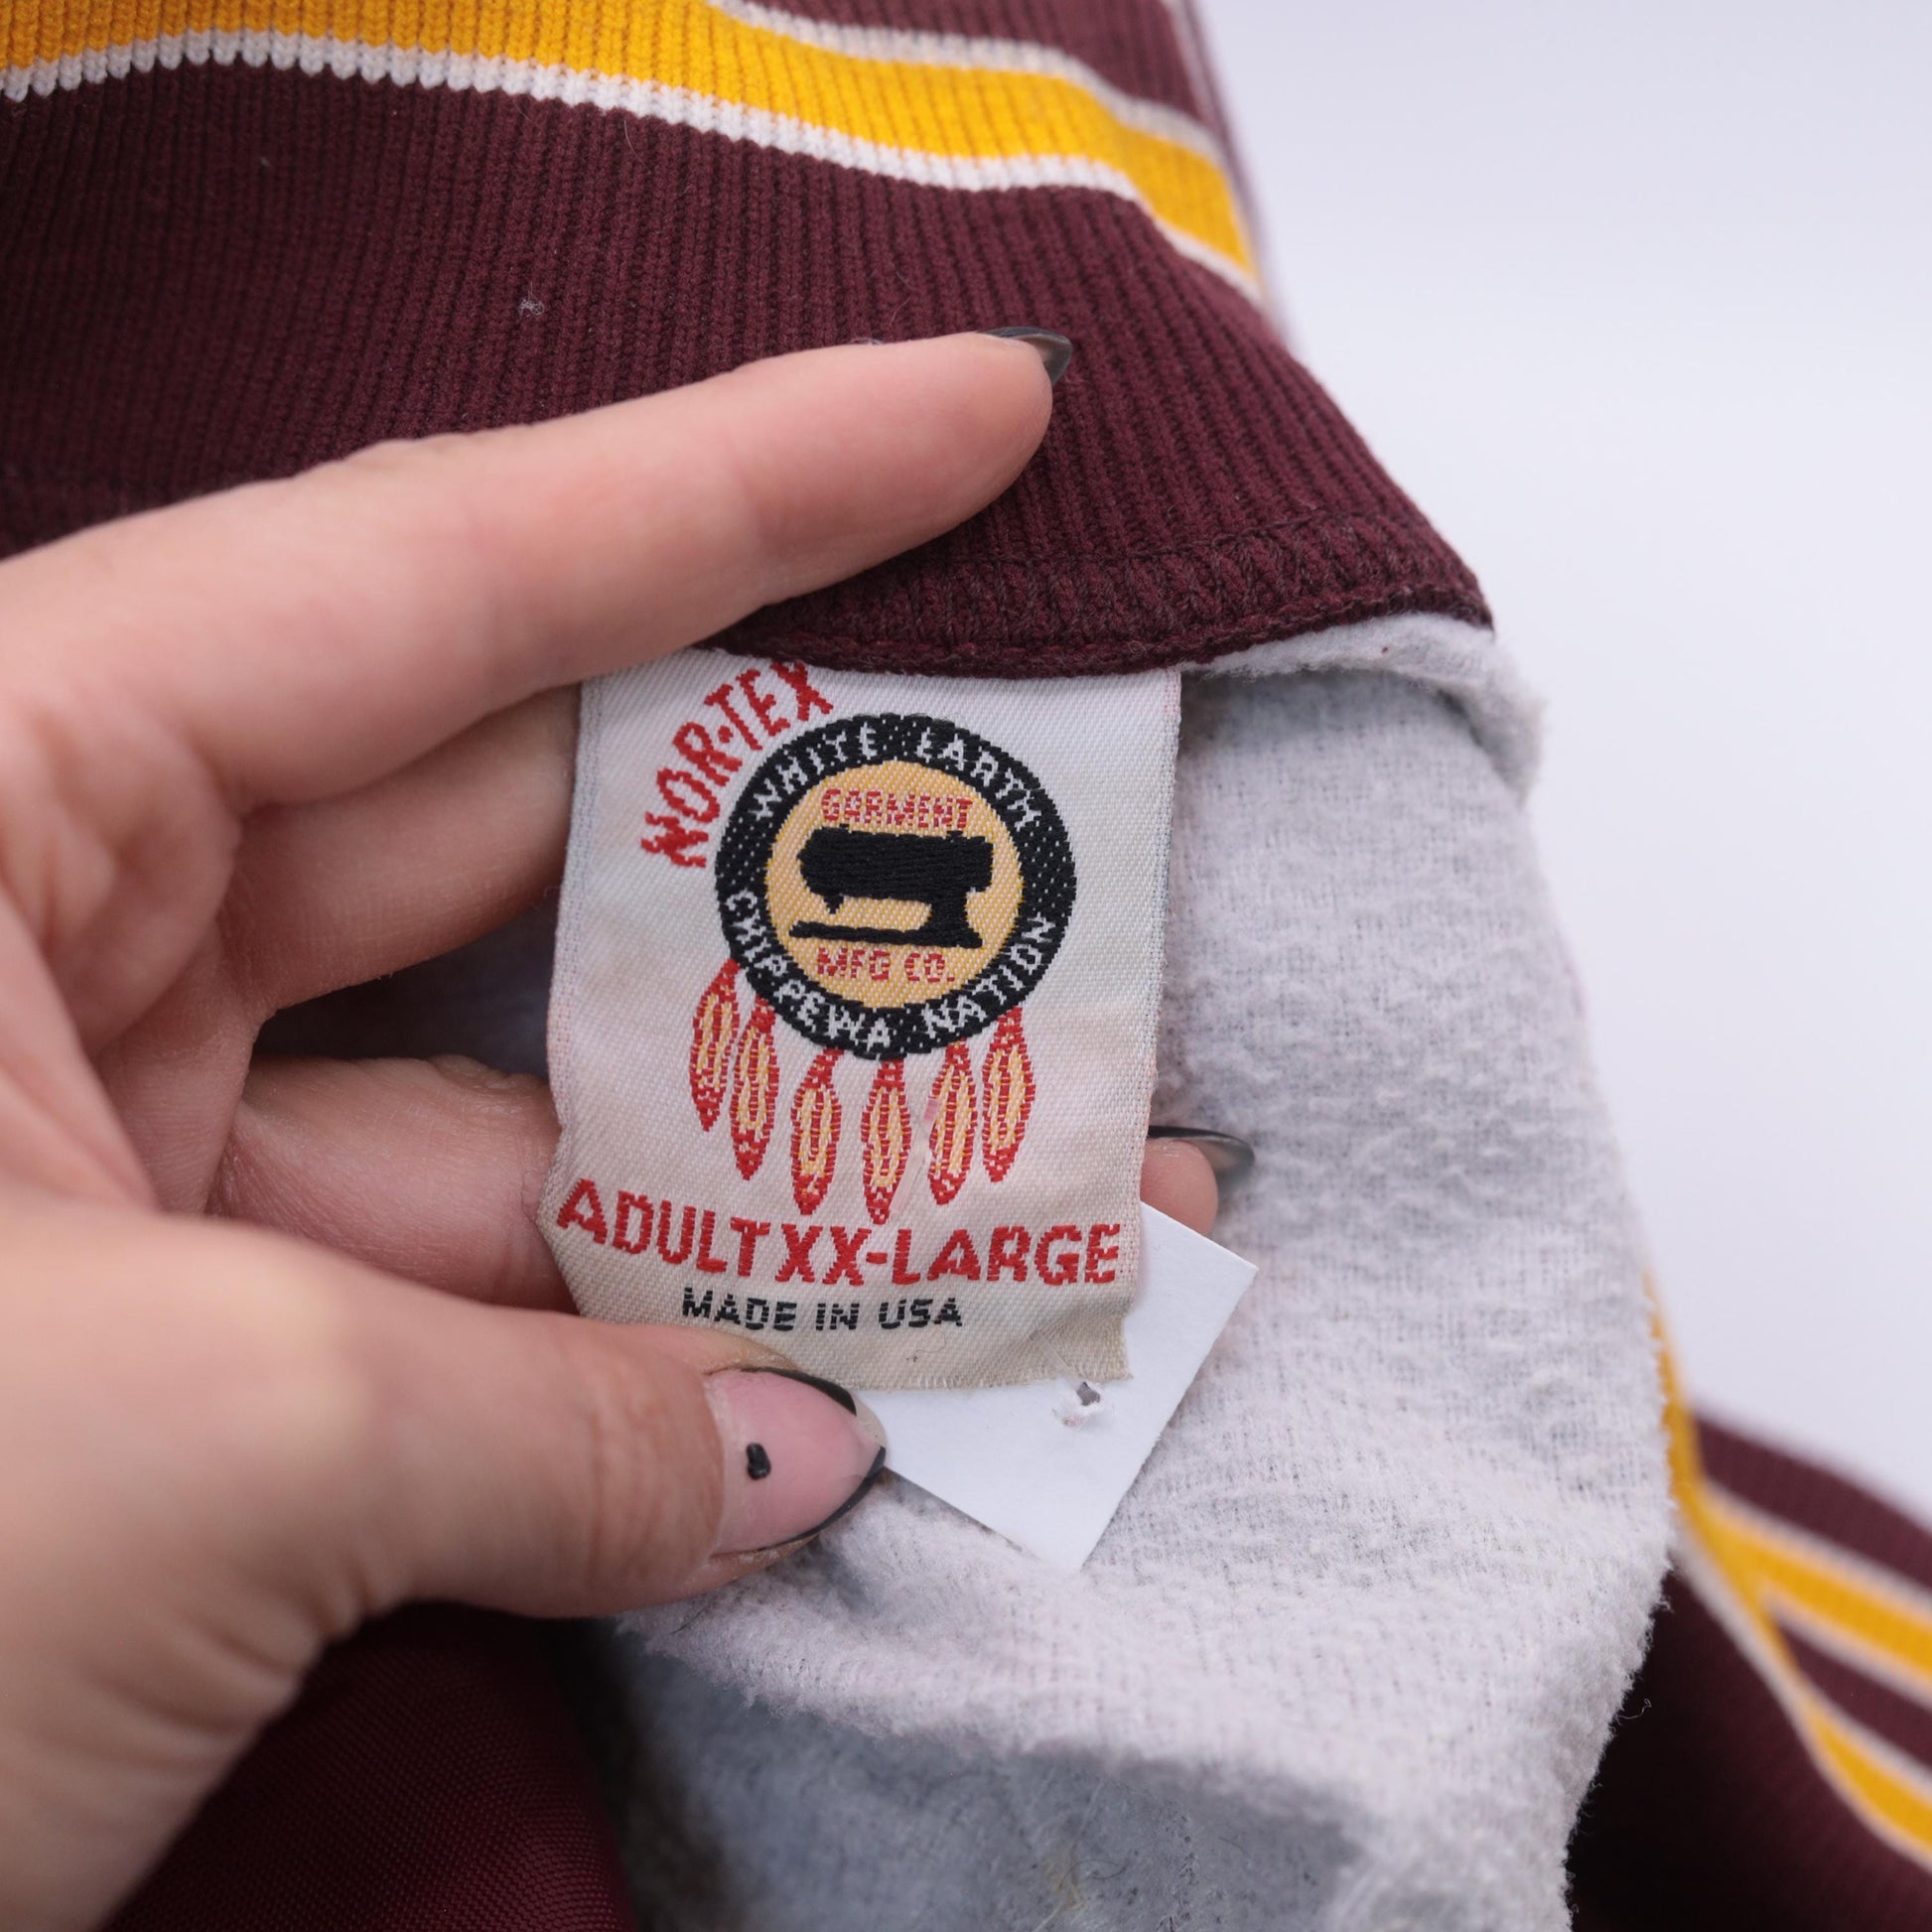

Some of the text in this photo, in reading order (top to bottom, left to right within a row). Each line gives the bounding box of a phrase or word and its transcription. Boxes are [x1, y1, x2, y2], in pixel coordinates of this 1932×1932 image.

[749, 722, 1044, 830] WHITE EARTH
[822, 789, 973, 830] GARMENT
[726, 891, 1056, 1049] CHIPPEWA NATION
[818, 947, 955, 983] MFG CO.
[556, 1178, 770, 1278] ADULT
[682, 1287, 963, 1331] MADE IN USA
